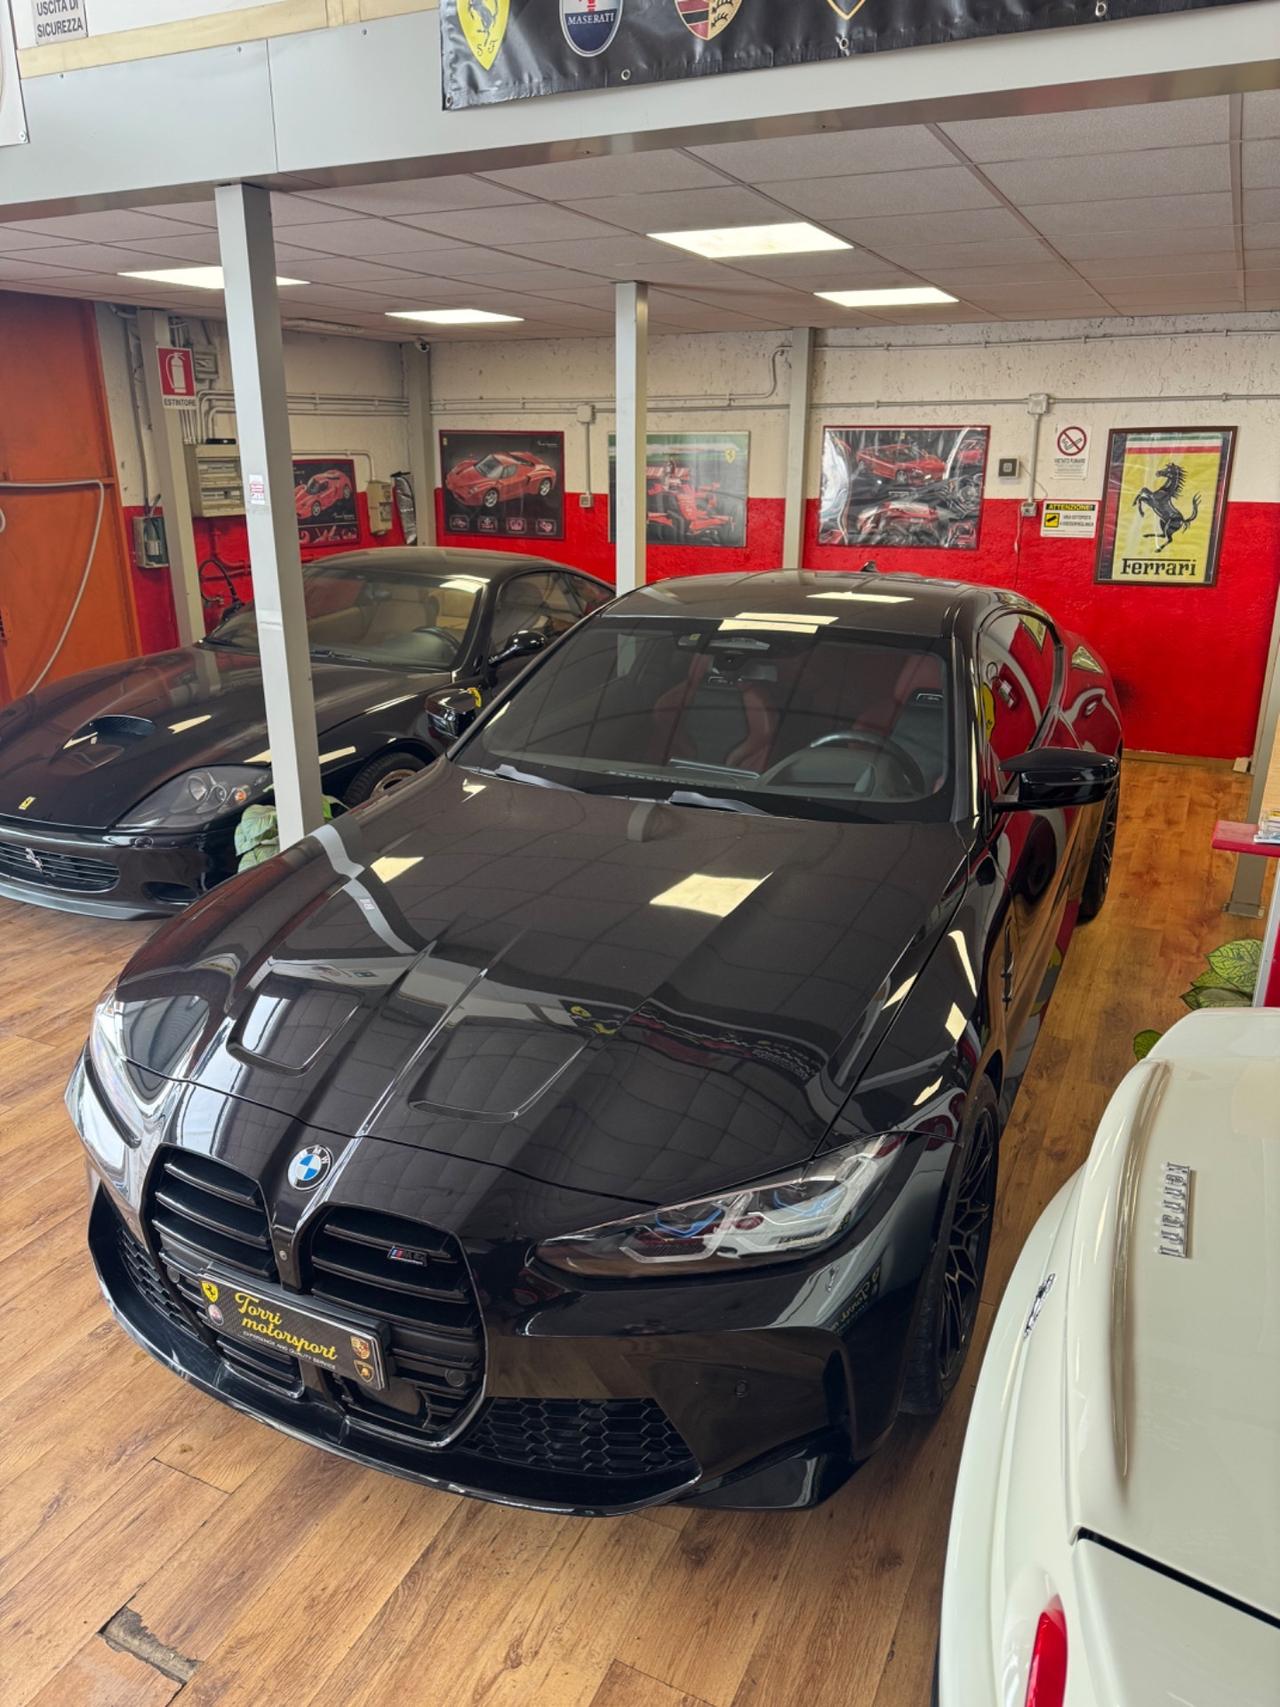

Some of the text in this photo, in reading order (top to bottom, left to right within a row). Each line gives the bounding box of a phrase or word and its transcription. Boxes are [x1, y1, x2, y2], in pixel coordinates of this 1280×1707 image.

[37, 0, 79, 16] USCITA DI
[37, 17, 84, 38] SICUREZZA
[568, 12, 615, 25] MASERATI
[164, 398, 196, 407] ESTINTORE
[1120, 558, 1196, 576] Ferrari
[235, 1292, 281, 1324] Torri
[242, 1318, 337, 1360] motorsport
